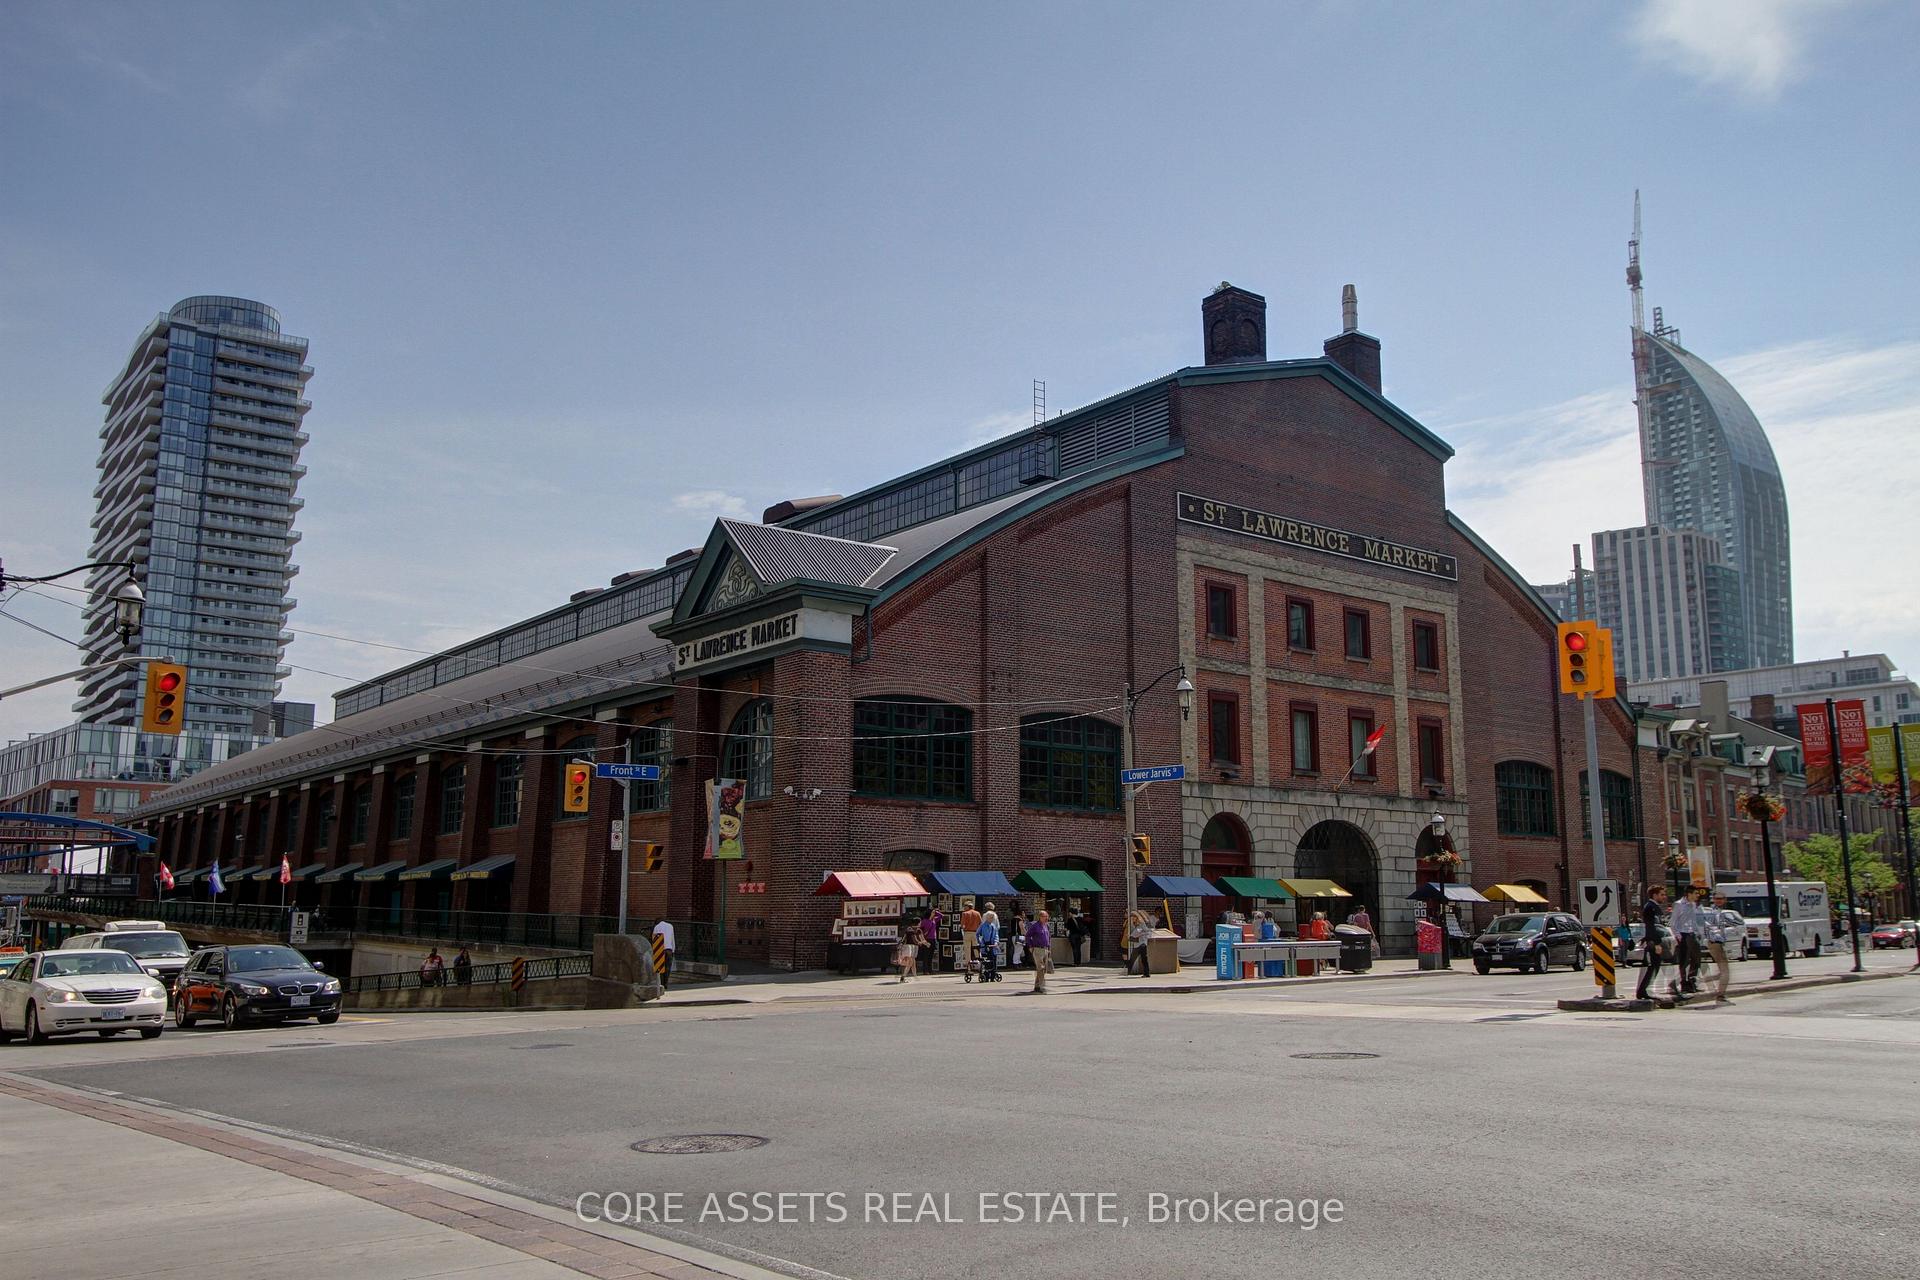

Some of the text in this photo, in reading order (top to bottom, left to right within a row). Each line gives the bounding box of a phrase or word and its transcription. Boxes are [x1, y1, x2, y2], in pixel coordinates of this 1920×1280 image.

[1241, 511, 1350, 553] LAWRENCE
[1364, 540, 1438, 572] MARKET
[693, 629, 747, 661] LAWRENCE
[751, 613, 798, 647] MARKET
[610, 765, 634, 775] Front
[641, 767, 647, 775] E
[1128, 771, 1149, 780] Lower
[1150, 767, 1172, 778] Jarvis
